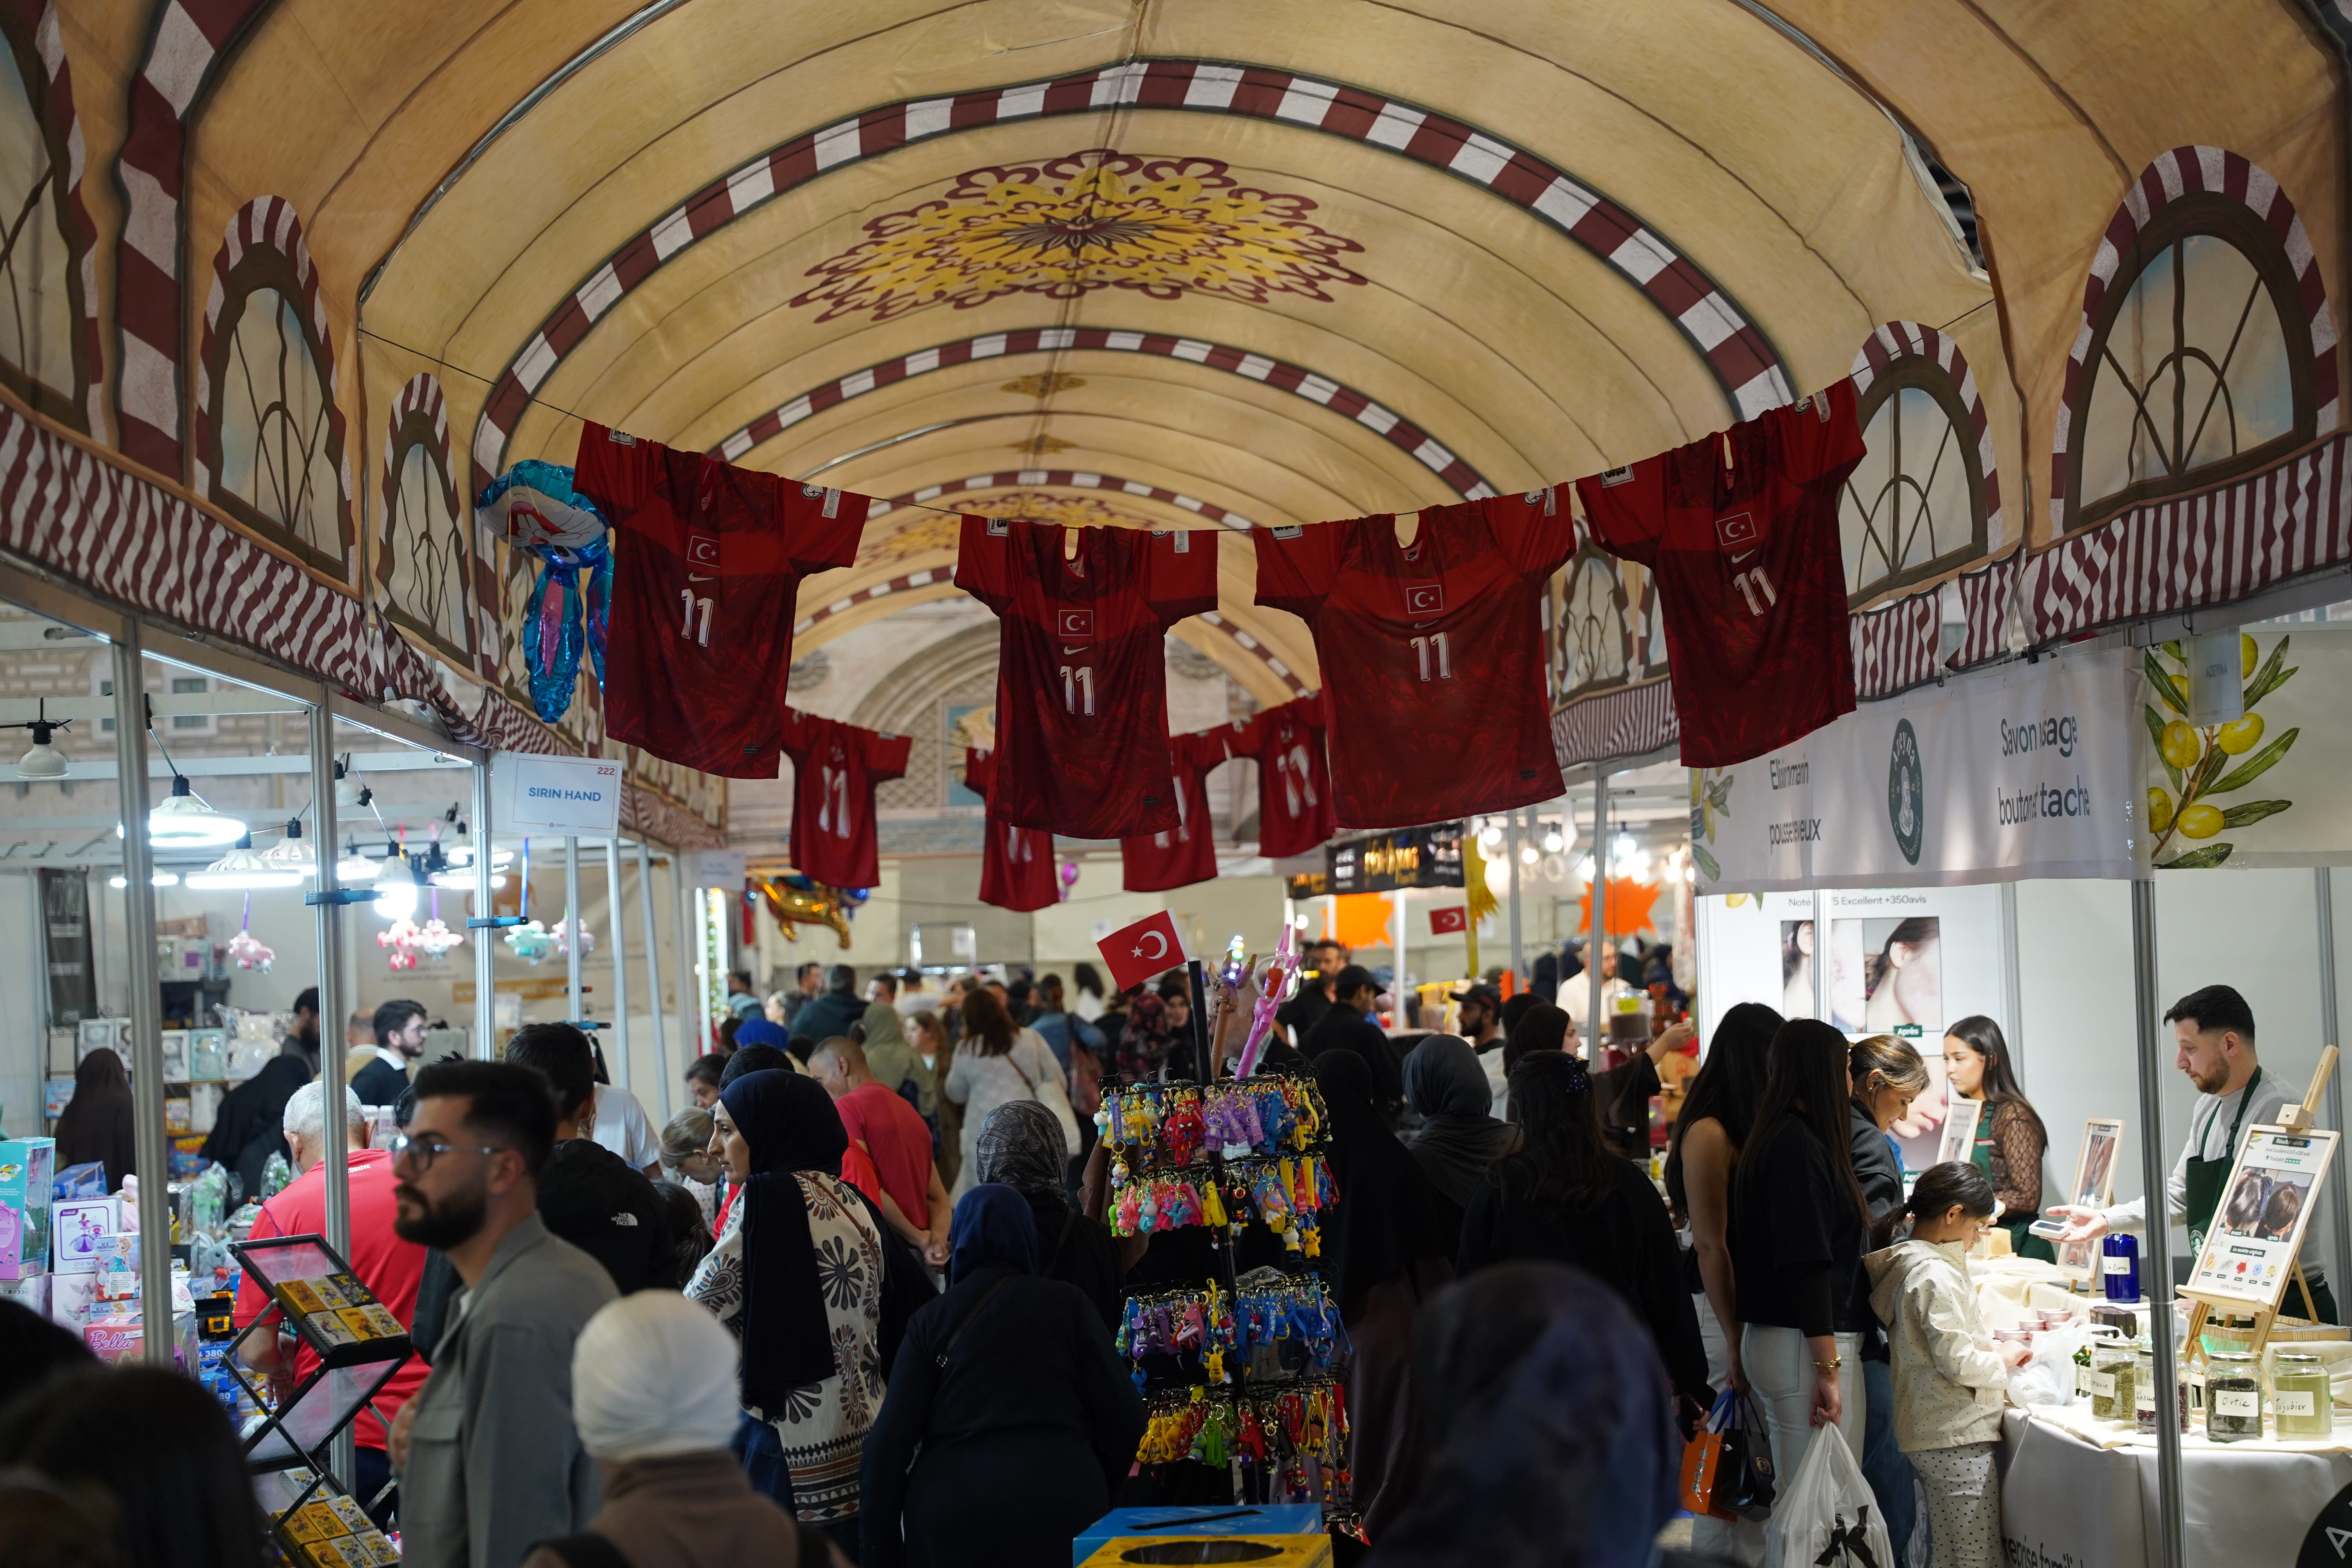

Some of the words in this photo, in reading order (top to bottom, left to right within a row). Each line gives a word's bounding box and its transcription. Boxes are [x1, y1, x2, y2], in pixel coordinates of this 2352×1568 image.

[827, 488, 836, 517] FOUNDATIO
[1733, 566, 1777, 616] 11
[682, 589, 714, 647] 11
[1410, 632, 1451, 681] 11
[1060, 666, 1094, 715] 11
[2001, 719, 2037, 756] Savon
[597, 767, 615, 775] 222
[1277, 746, 1318, 818] 11
[529, 787, 561, 799] SIRIN
[565, 790, 601, 801] HAND
[2040, 775, 2090, 817] tache
[1788, 897, 1811, 906] Noté
[1842, 896, 1882, 905] Excellent
[1897, 1027, 1919, 1037] Après
[90, 1330, 134, 1351] Bella
[2222, 1397, 2250, 1407] Ortie
